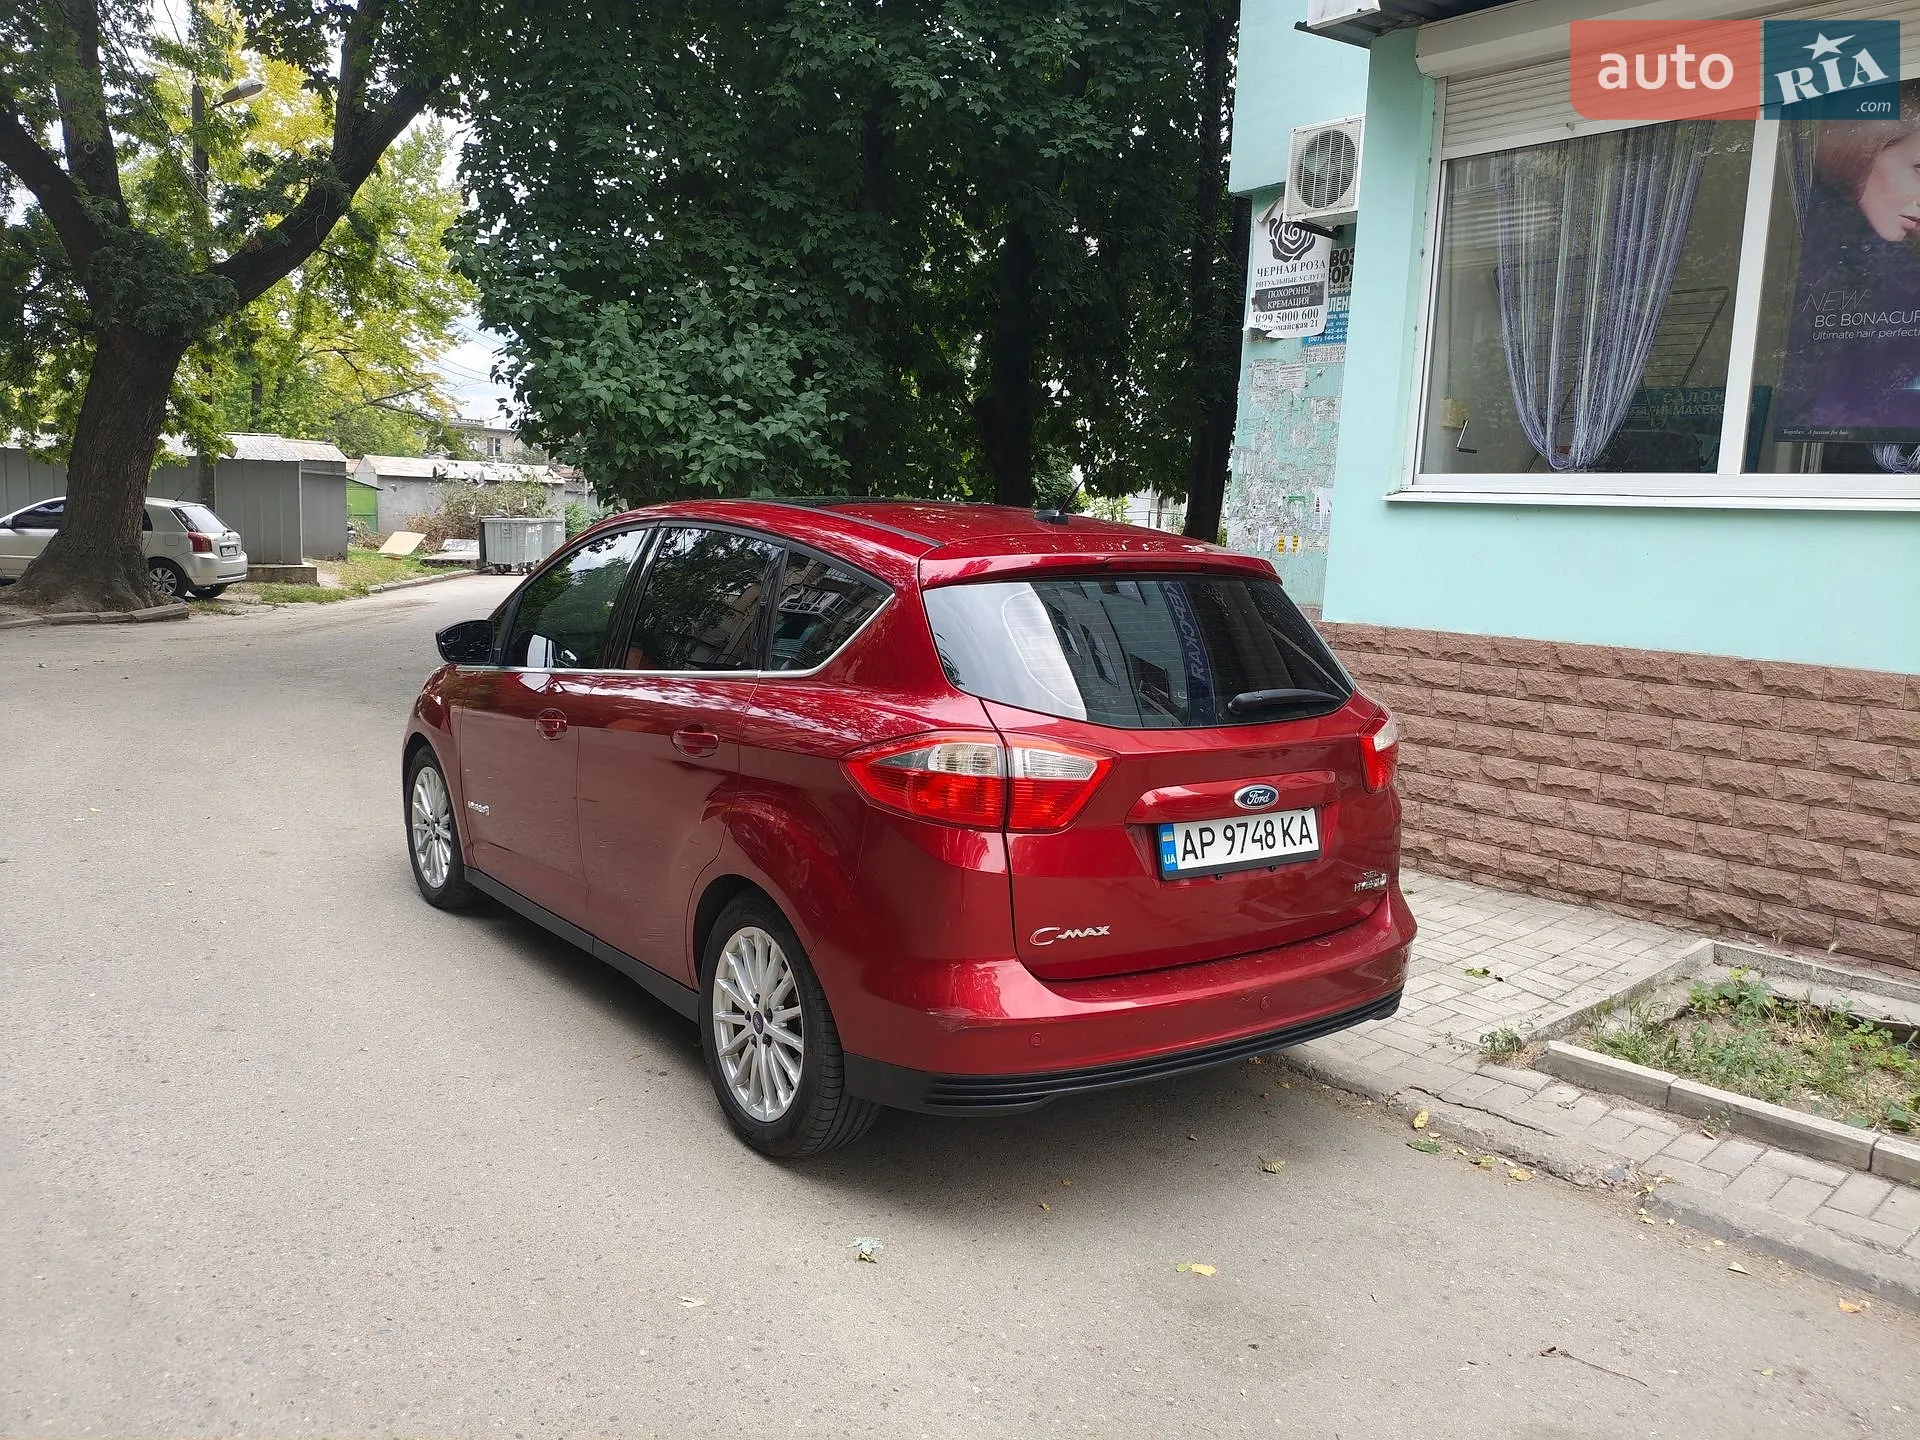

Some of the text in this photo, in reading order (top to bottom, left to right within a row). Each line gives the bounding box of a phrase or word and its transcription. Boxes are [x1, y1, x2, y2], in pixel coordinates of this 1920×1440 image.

[1257, 260, 1325, 277] ЧЕРНАЯ РОЗА
[1329, 266, 1353, 284] ОР
[1267, 285, 1311, 299] ПОХОРОНЫ
[1267, 296, 1310, 309] КРЕМАЦИЯ
[1802, 288, 1868, 312] NEW
[1255, 313, 1273, 323] 099
[1276, 310, 1298, 323] 5000
[1302, 308, 1319, 320] 600
[1814, 314, 1837, 328] BC
[1310, 319, 1318, 328] 21
[1812, 330, 1855, 341] Ultimate
[1857, 329, 1876, 338] hair
[1663, 391, 1724, 403] САЛОН
[1164, 815, 1313, 865] UA AP 9748 KA
